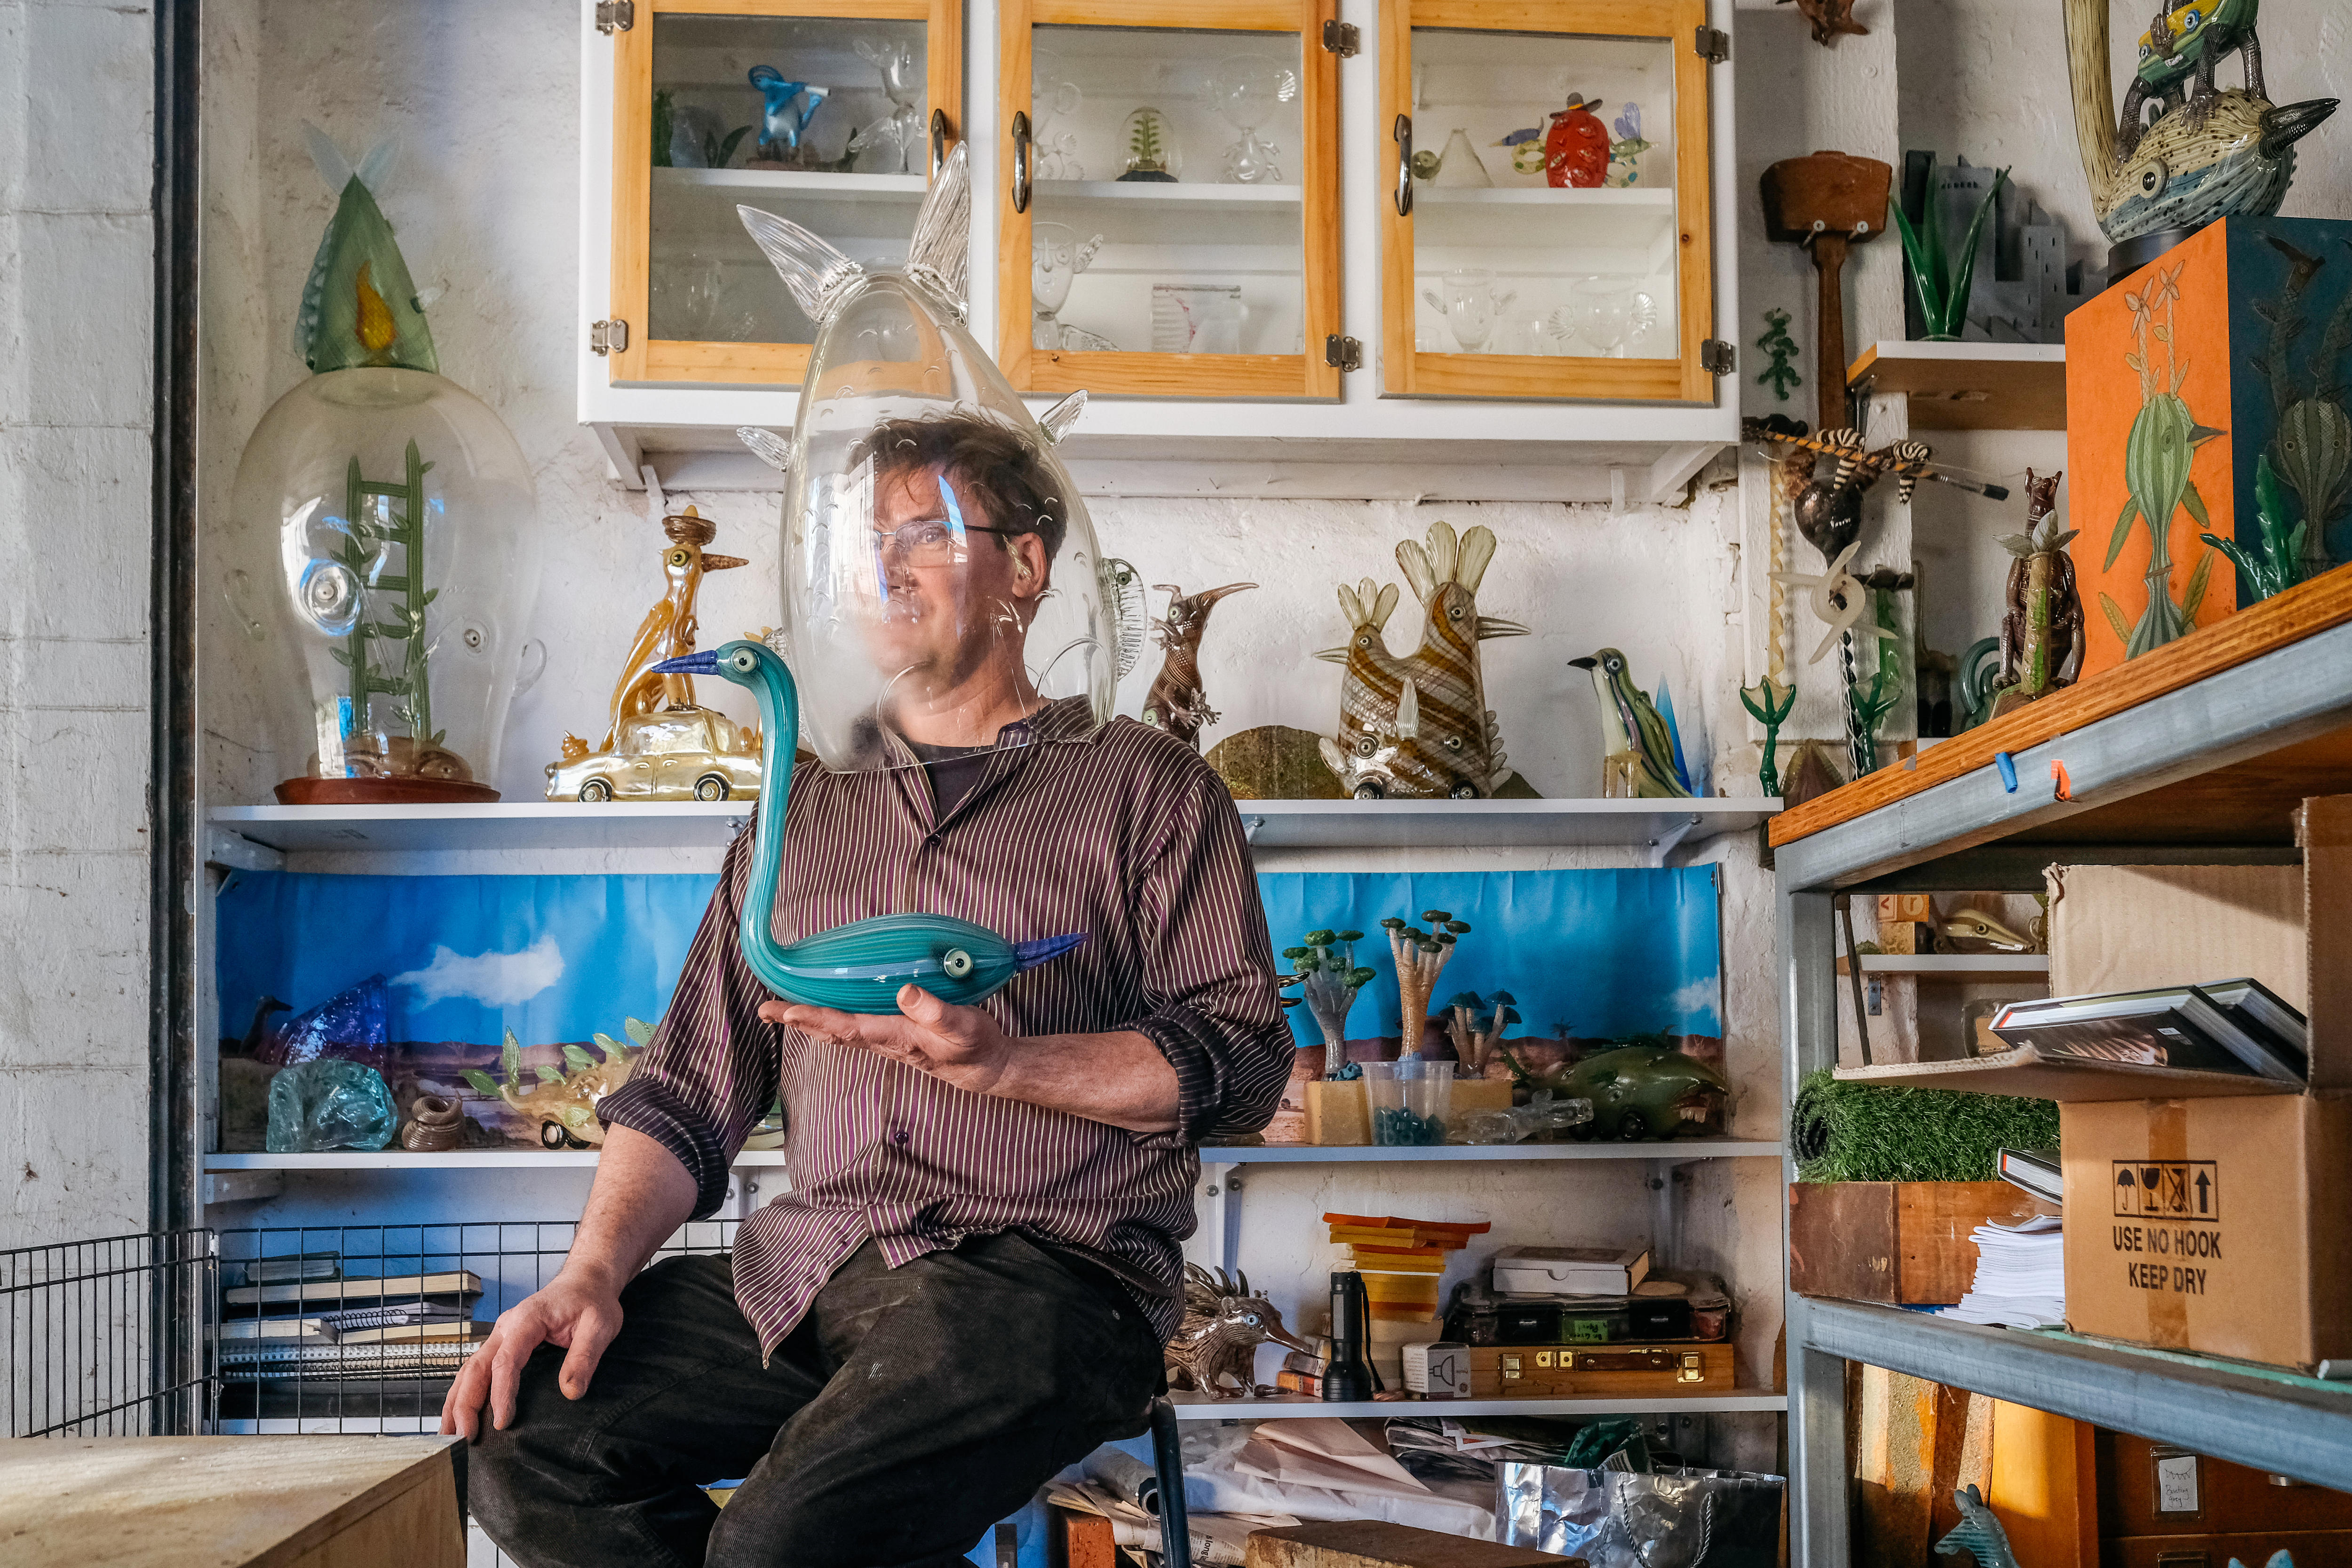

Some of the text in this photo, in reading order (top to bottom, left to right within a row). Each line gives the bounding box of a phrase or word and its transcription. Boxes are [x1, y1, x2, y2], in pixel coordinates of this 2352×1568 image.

[2114, 1226, 2222, 1259] USE NO HOOK
[2129, 1262, 2207, 1295] KEEP DRY
[1200, 1540, 1213, 1556] long
